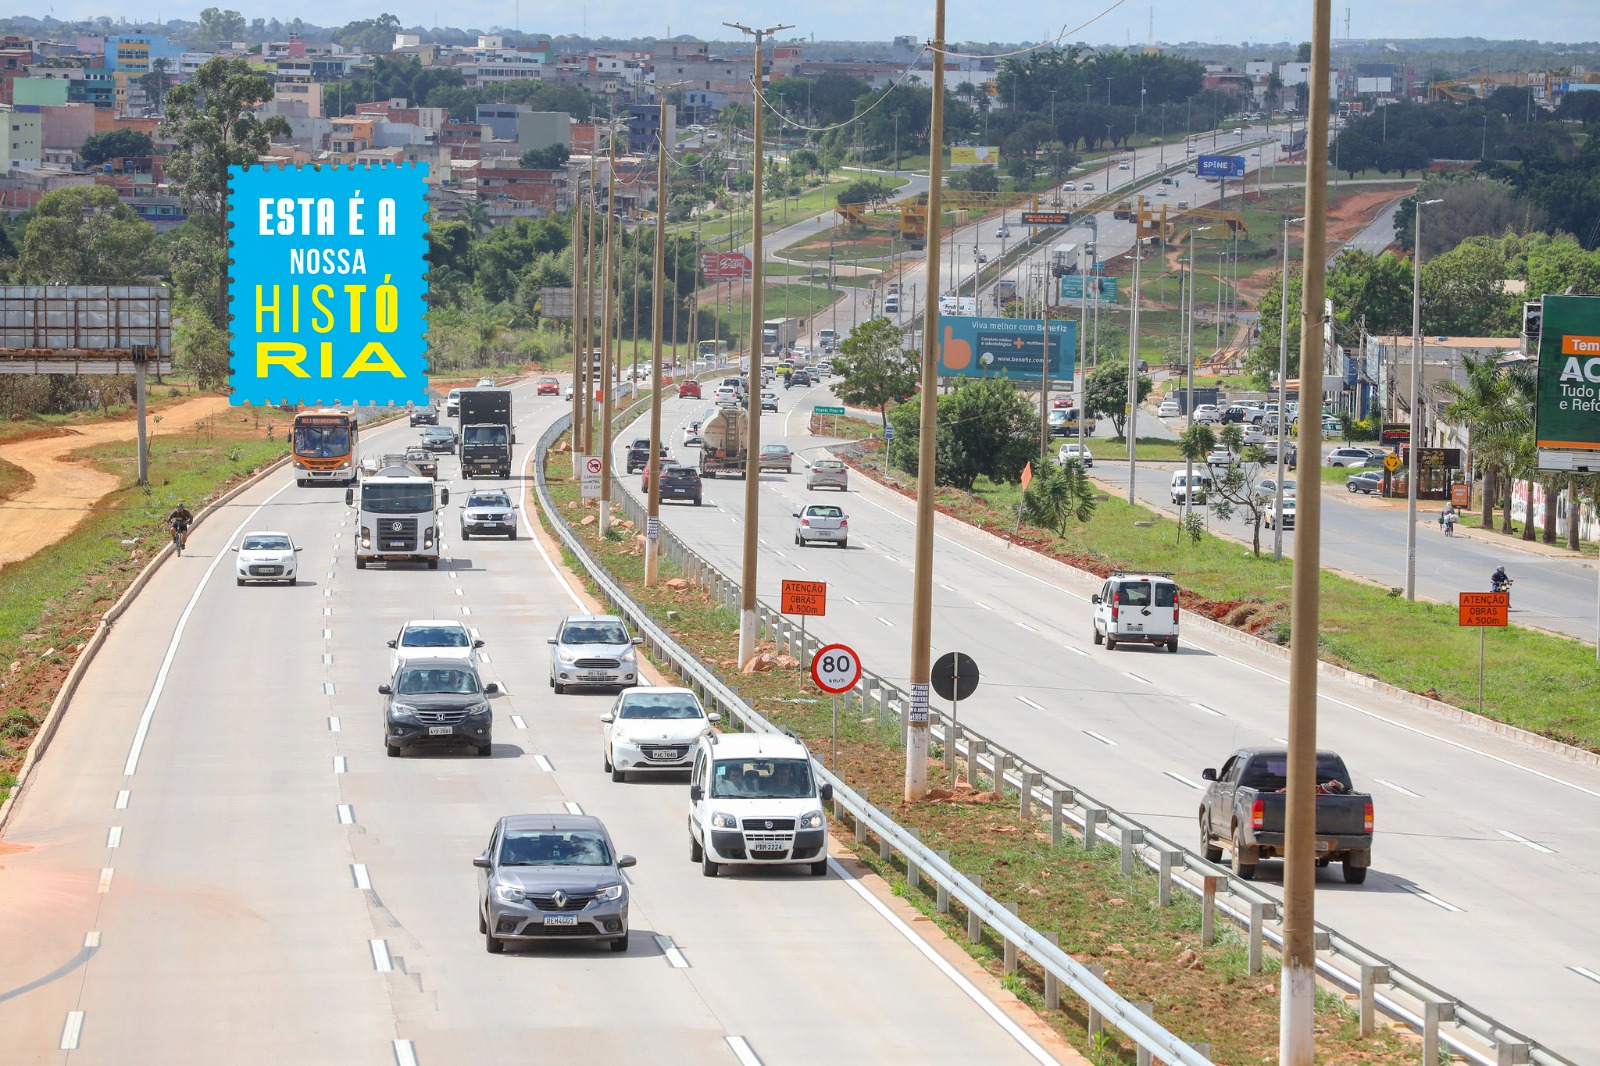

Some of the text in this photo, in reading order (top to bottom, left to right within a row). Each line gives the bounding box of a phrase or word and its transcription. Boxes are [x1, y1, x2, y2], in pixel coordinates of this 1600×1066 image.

[1203, 161, 1228, 169] SPINE
[971, 321, 988, 329] Viva
[989, 322, 1017, 331] melhor
[1571, 338, 1600, 352] Tem
[1559, 384, 1594, 398] Tudo
[1559, 400, 1568, 410] e
[785, 583, 823, 594] ATENÇÃO
[790, 596, 816, 605] OBRAS
[1463, 594, 1505, 606] ATENÇÃO
[788, 604, 818, 614] A 500m
[1470, 607, 1498, 615] OBRAS
[1467, 616, 1500, 625] A 500m
[822, 655, 850, 673] 80
